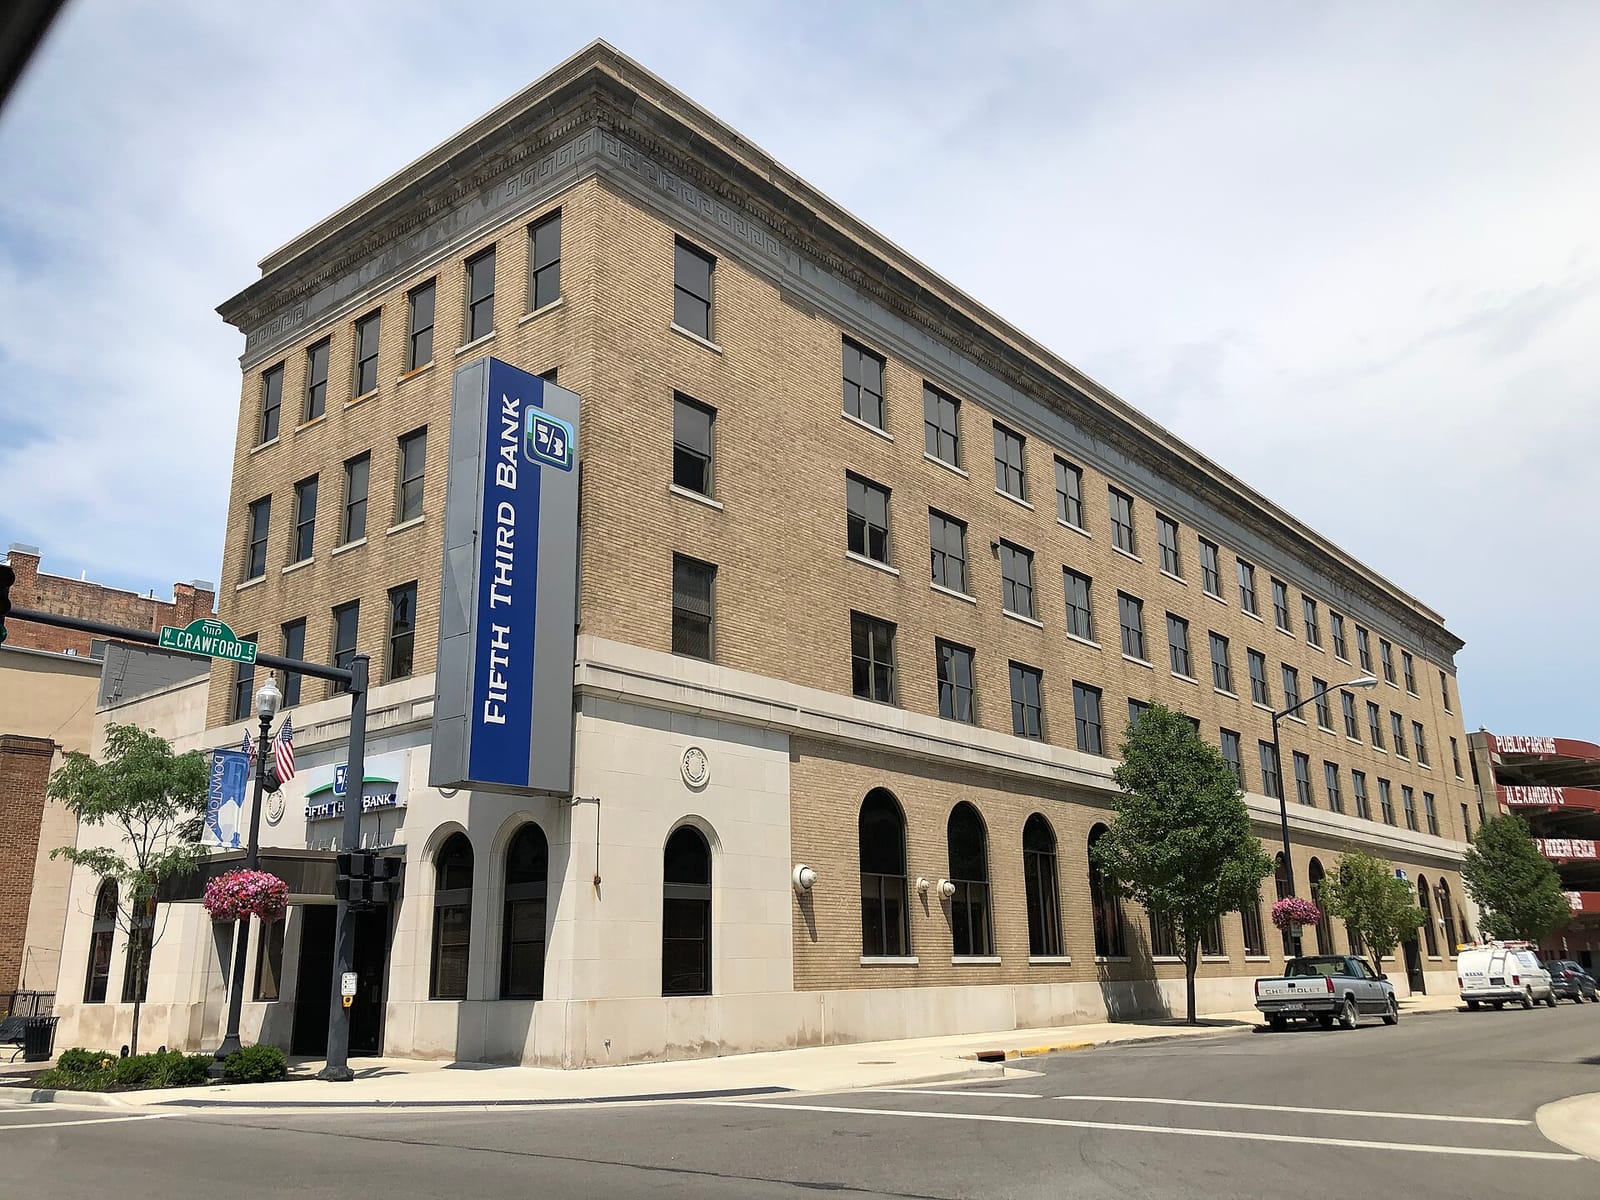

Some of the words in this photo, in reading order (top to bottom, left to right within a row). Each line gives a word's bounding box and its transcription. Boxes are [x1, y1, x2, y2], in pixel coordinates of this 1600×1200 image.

[496, 393, 520, 490] BANK
[490, 501, 515, 609] THIRD
[176, 631, 242, 658] CRAWFORD
[248, 644, 254, 655] E
[484, 622, 510, 724] FIFTH
[1496, 736, 1526, 753] PUBLIC
[1525, 736, 1556, 754] PARKING
[304, 803, 329, 817] FIFTH
[363, 793, 392, 809] BANK
[1506, 785, 1565, 805] ALEXANDRIA'S
[1265, 987, 1321, 996] CHEVROLET
